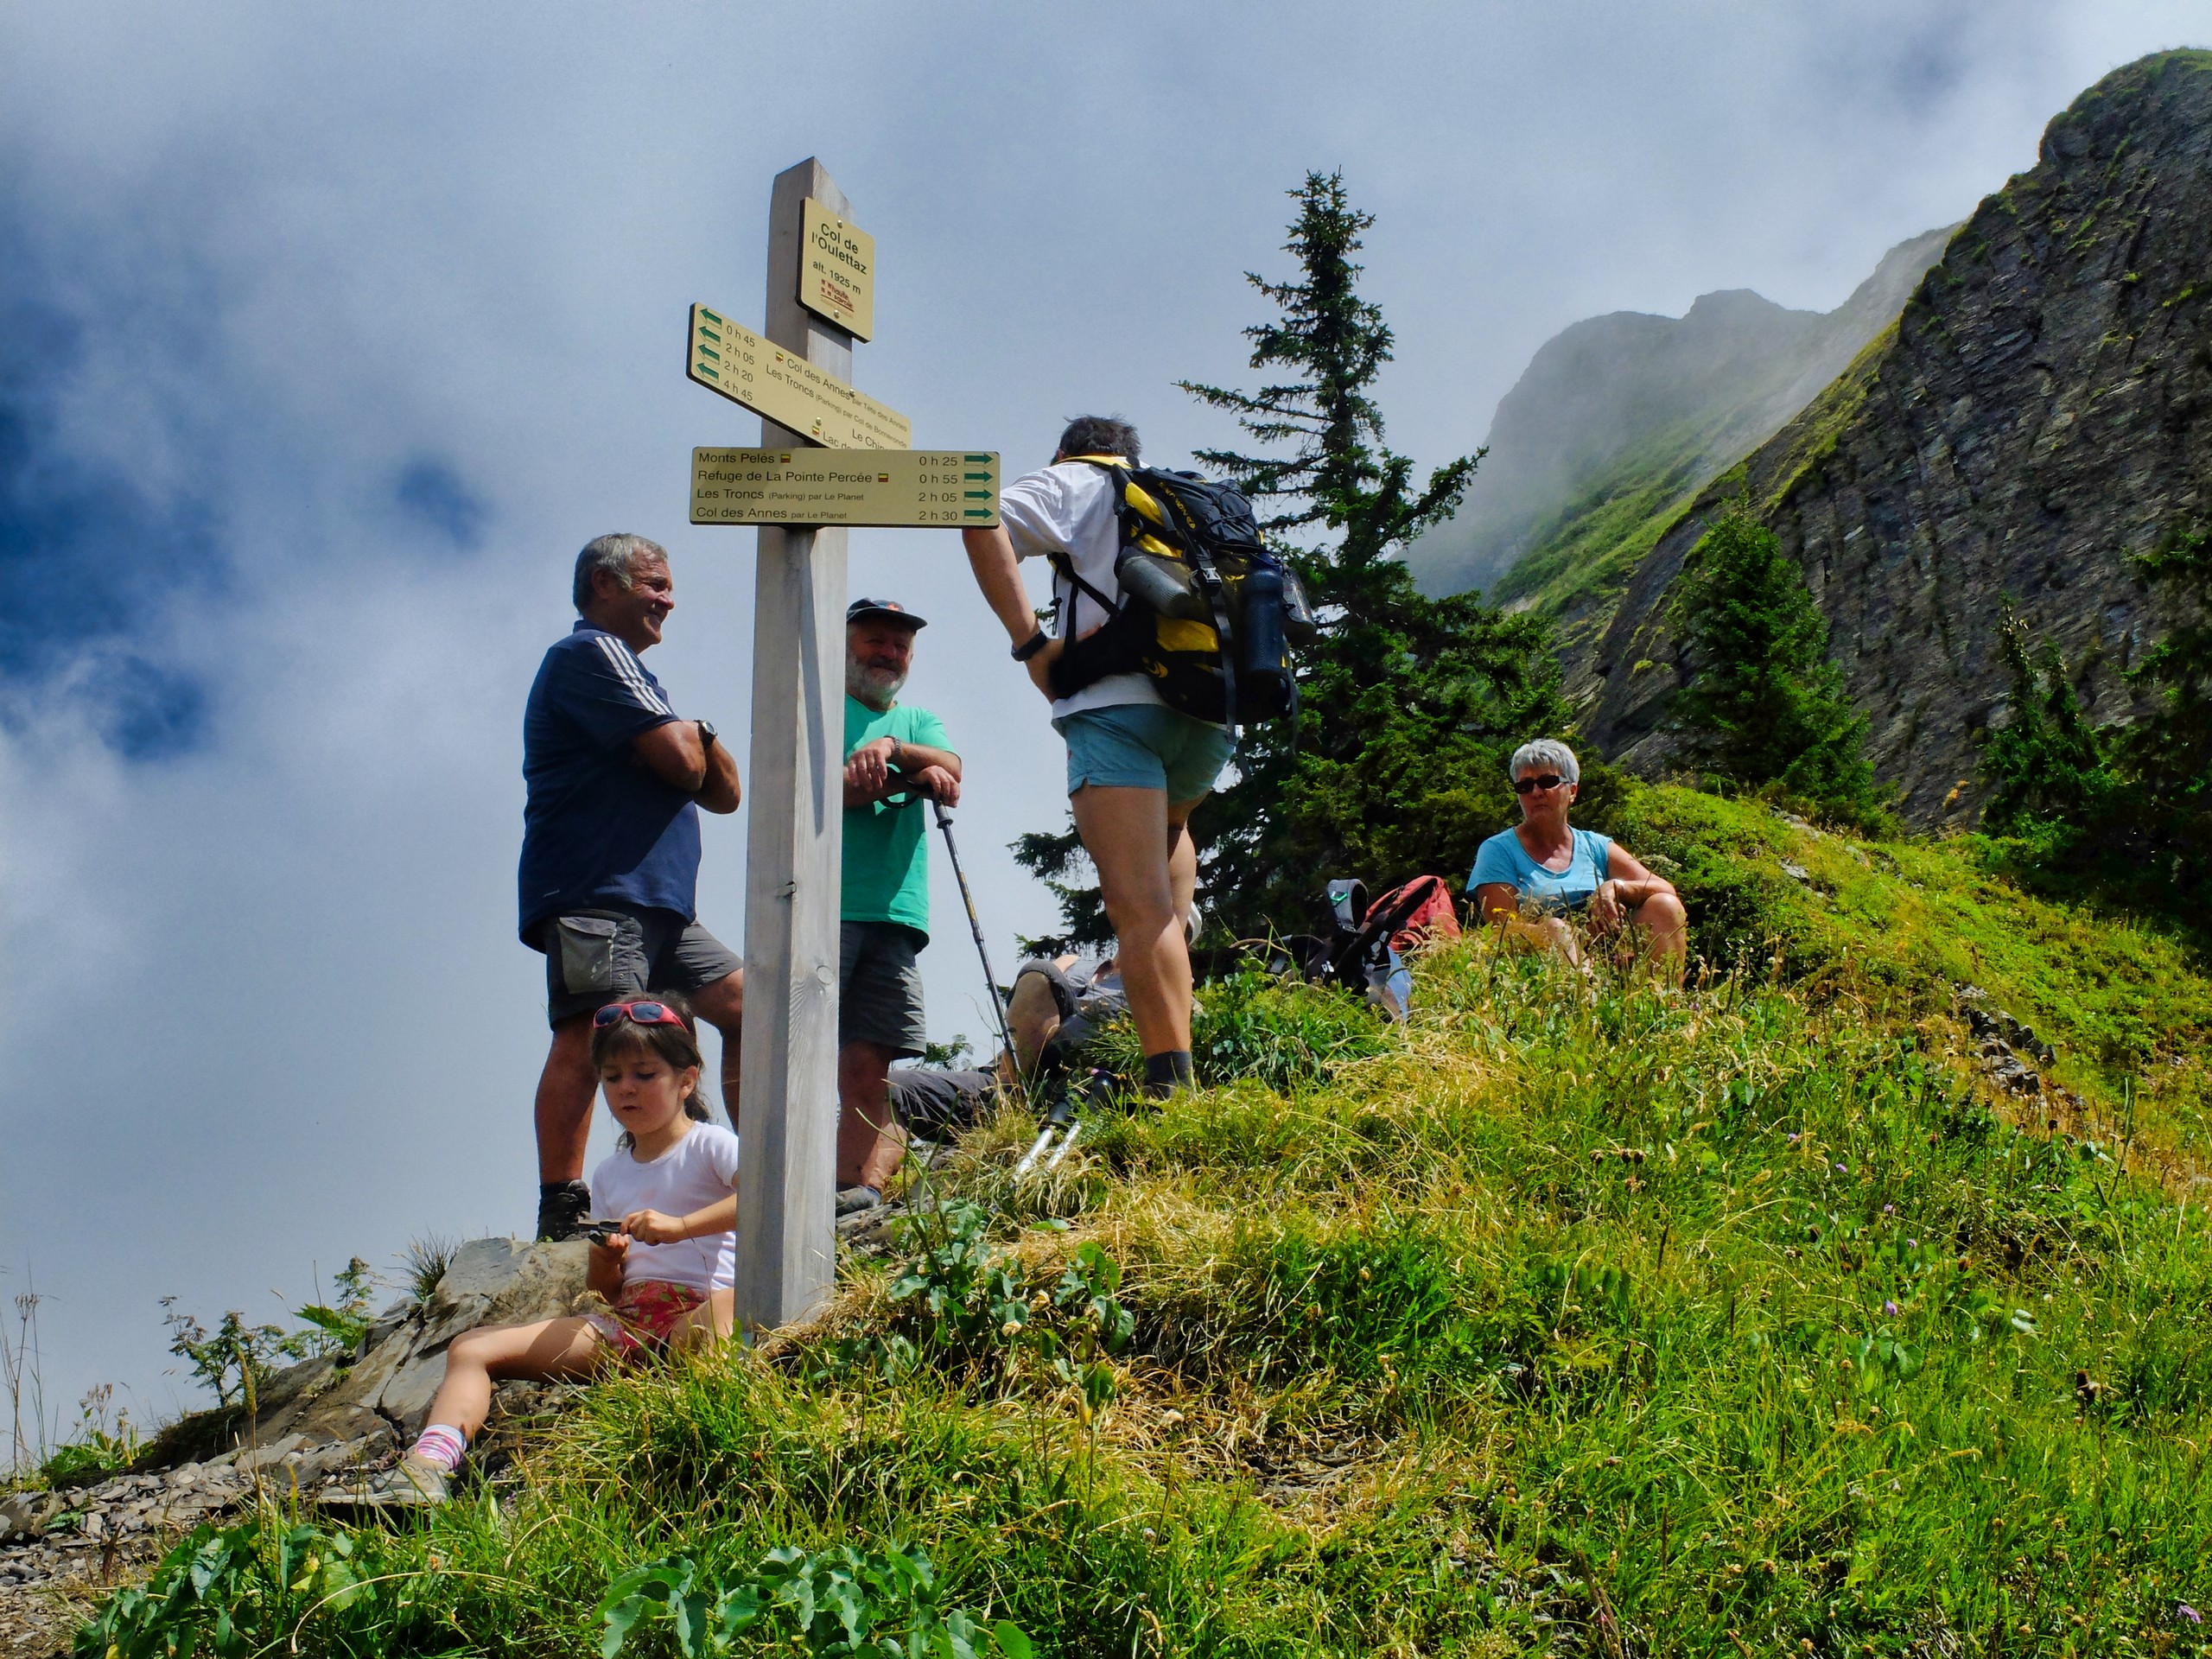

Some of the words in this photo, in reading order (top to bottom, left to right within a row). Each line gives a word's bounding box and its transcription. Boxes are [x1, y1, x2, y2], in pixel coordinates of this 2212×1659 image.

[811, 232, 867, 275] l'Oulettaz
[821, 223, 841, 244] Col
[844, 238, 859, 254] de
[812, 261, 826, 275] alt.
[830, 270, 850, 288] 1925
[852, 284, 861, 295] m
[726, 343, 732, 353] 2
[734, 346, 741, 358] h
[743, 352, 754, 365] 05
[766, 364, 782, 381] Les
[785, 373, 814, 398] Troncs
[727, 325, 733, 335] 0
[734, 329, 741, 340] h
[743, 335, 755, 347] 45
[787, 358, 802, 374] Col
[804, 369, 821, 384] des
[823, 378, 850, 400] Annes
[723, 380, 730, 389] 4
[733, 383, 739, 394] h
[741, 389, 753, 401] 45
[823, 431, 839, 448] Lac
[724, 360, 730, 371] 2
[733, 364, 739, 375] h
[741, 370, 753, 383] 20
[852, 428, 863, 442] Le
[698, 470, 742, 483] Refuge
[747, 471, 762, 481] de
[766, 472, 781, 481] La
[785, 472, 824, 482] Pointe
[829, 472, 873, 483] Percée
[918, 474, 927, 484] 0
[931, 474, 938, 484] h
[942, 474, 958, 484] 55
[699, 453, 736, 463] Monts
[741, 453, 775, 463] Pelés
[918, 456, 927, 467] 0
[931, 456, 938, 467] h
[942, 457, 958, 467] 25
[696, 488, 720, 499] Les
[723, 488, 765, 499] Troncs
[769, 493, 805, 501] (Parking)
[918, 493, 926, 502] 2
[930, 493, 938, 502] h
[942, 493, 957, 502] 05
[696, 507, 717, 518] Col
[721, 508, 744, 518] des
[747, 508, 787, 518] Annes
[918, 511, 926, 521] 2
[931, 511, 938, 521] h
[942, 512, 958, 521] 30
